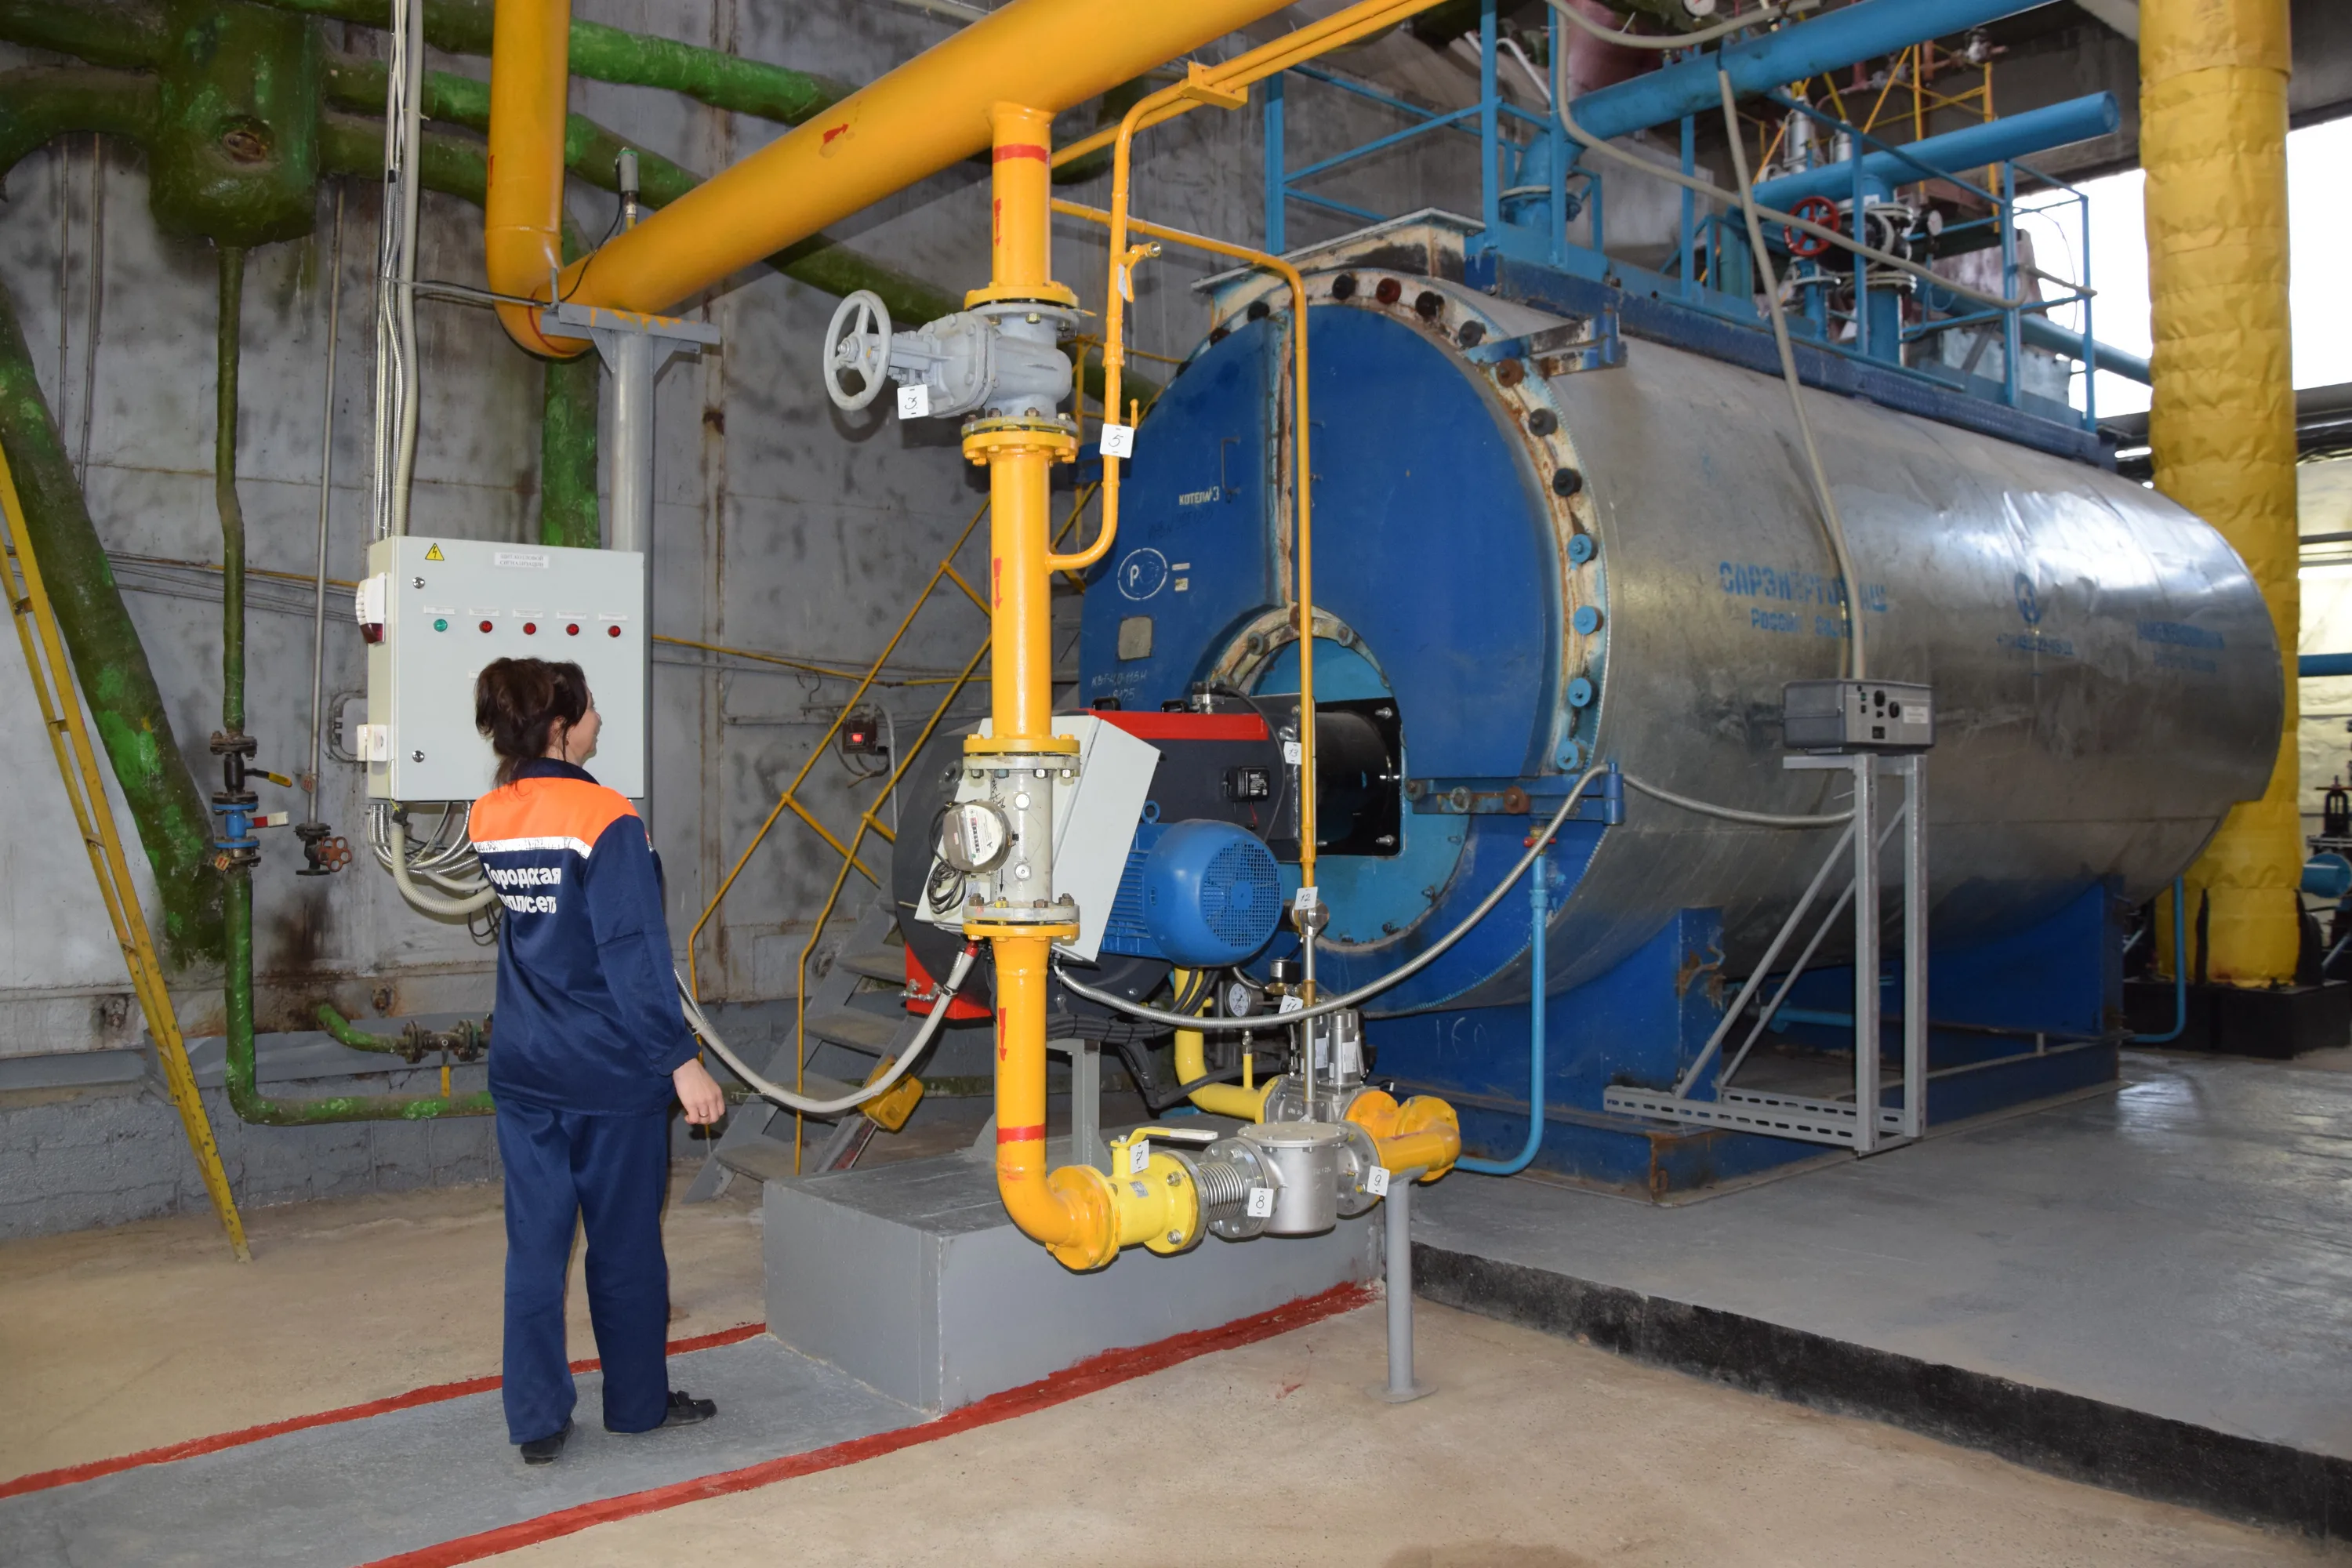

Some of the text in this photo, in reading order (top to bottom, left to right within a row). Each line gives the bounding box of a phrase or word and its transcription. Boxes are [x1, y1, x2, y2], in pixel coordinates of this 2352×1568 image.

[904, 396, 917, 410] 3
[1108, 434, 1124, 448] 5
[1288, 748, 1299, 757] 13
[484, 862, 561, 890] Городская
[1300, 893, 1311, 902] 12
[1135, 1149, 1144, 1165] 7
[1374, 1174, 1382, 1186] 9
[1255, 1195, 1265, 1209] 8
